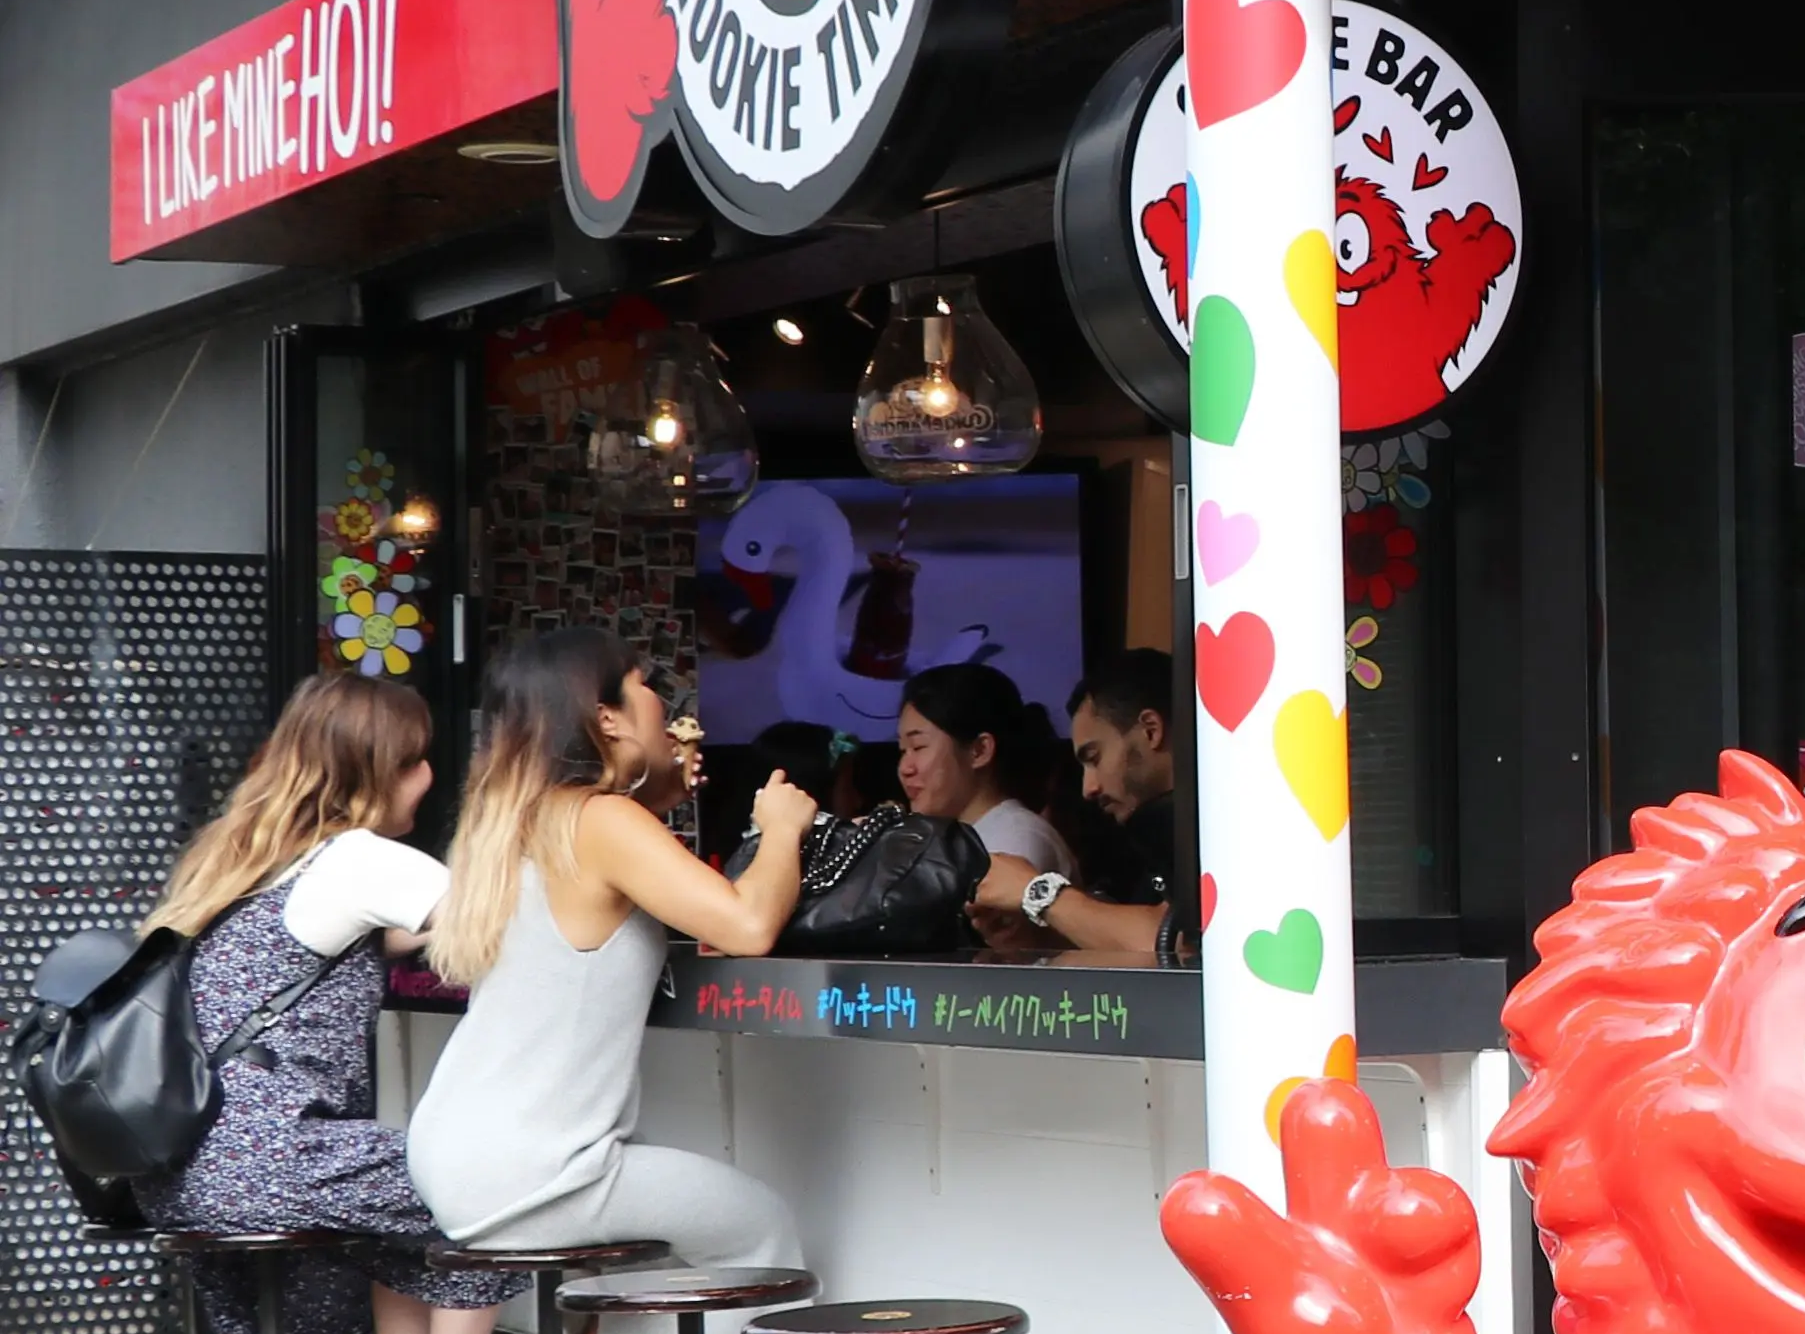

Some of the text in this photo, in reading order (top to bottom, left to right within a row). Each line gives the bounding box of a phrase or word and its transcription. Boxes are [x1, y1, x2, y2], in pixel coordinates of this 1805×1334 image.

[142, 117, 152, 225] I
[158, 75, 219, 219] LIKE
[223, 34, 298, 189] MINE
[1364, 27, 1475, 145] BAR
[817, 982, 917, 1030] #クッキードウ
